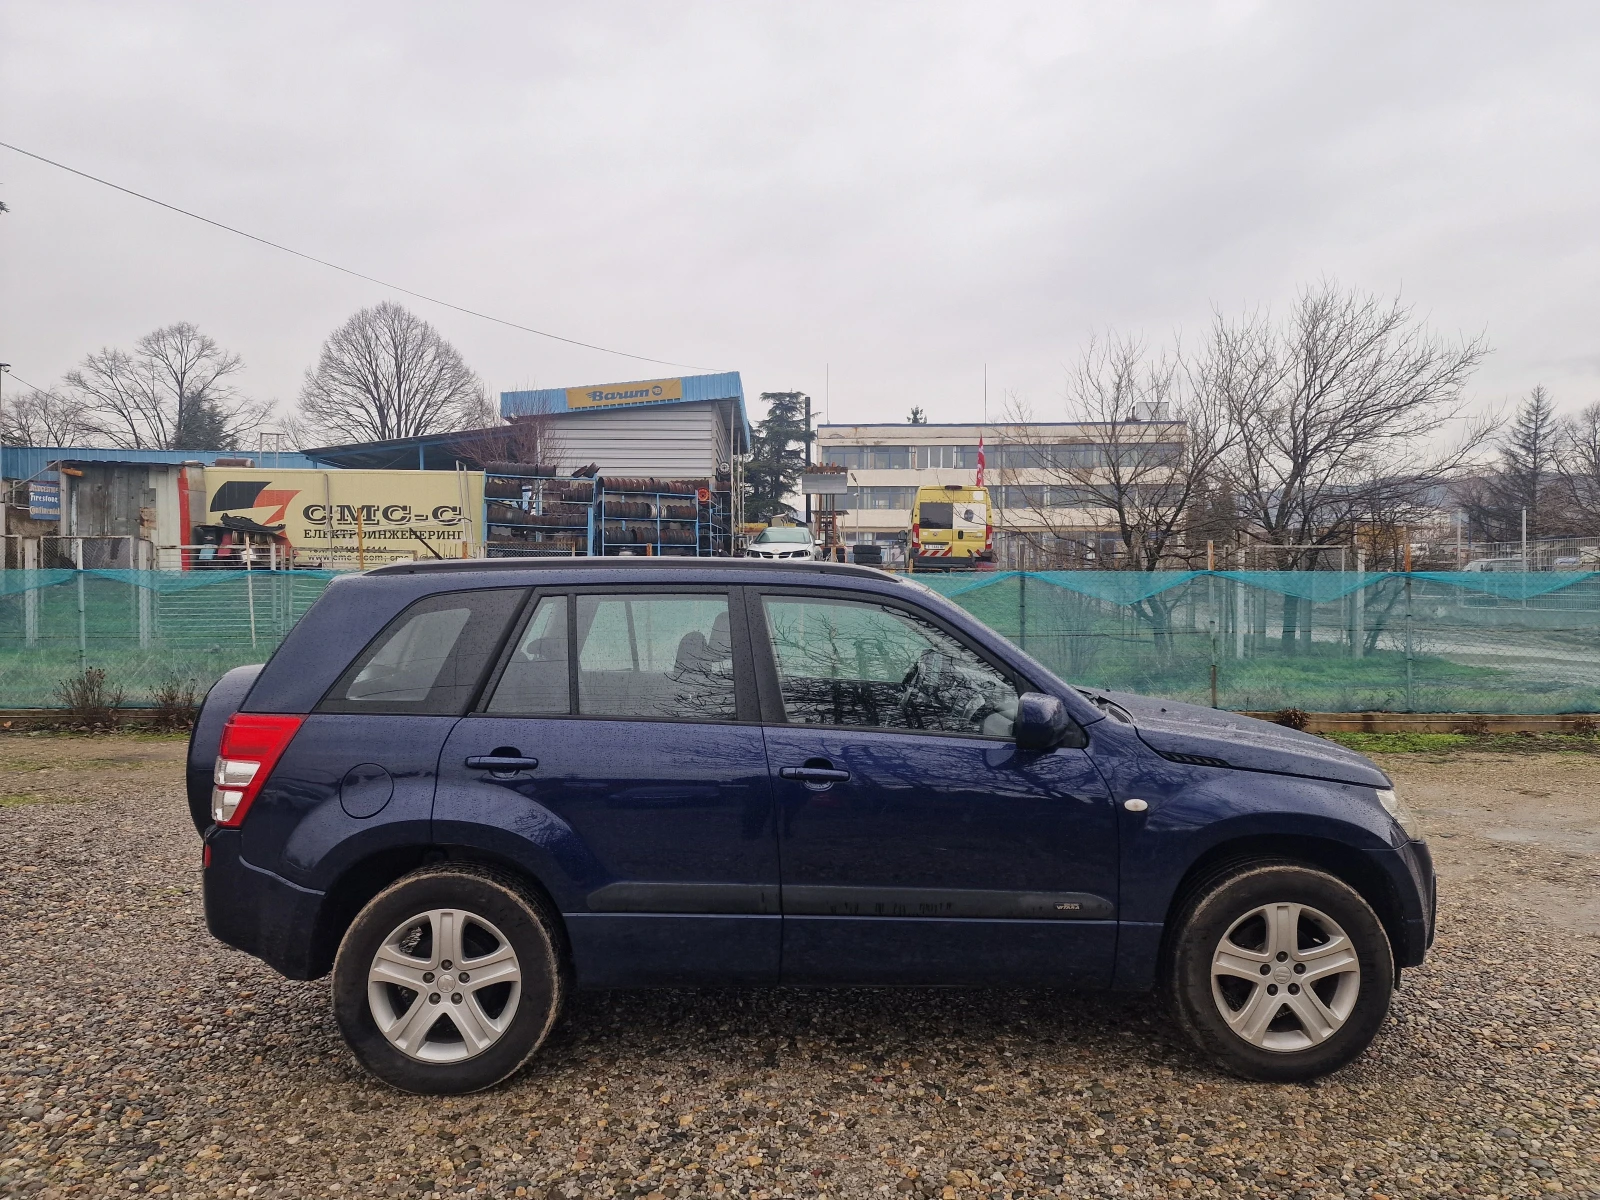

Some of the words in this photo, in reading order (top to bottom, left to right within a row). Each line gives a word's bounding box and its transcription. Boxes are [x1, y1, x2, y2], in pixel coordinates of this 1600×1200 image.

[591, 389, 649, 402] Barum
[30, 492, 58, 503] Firestone
[303, 529, 464, 540] ЕЛЕКТРОИНЖЕНЕРИНГ
